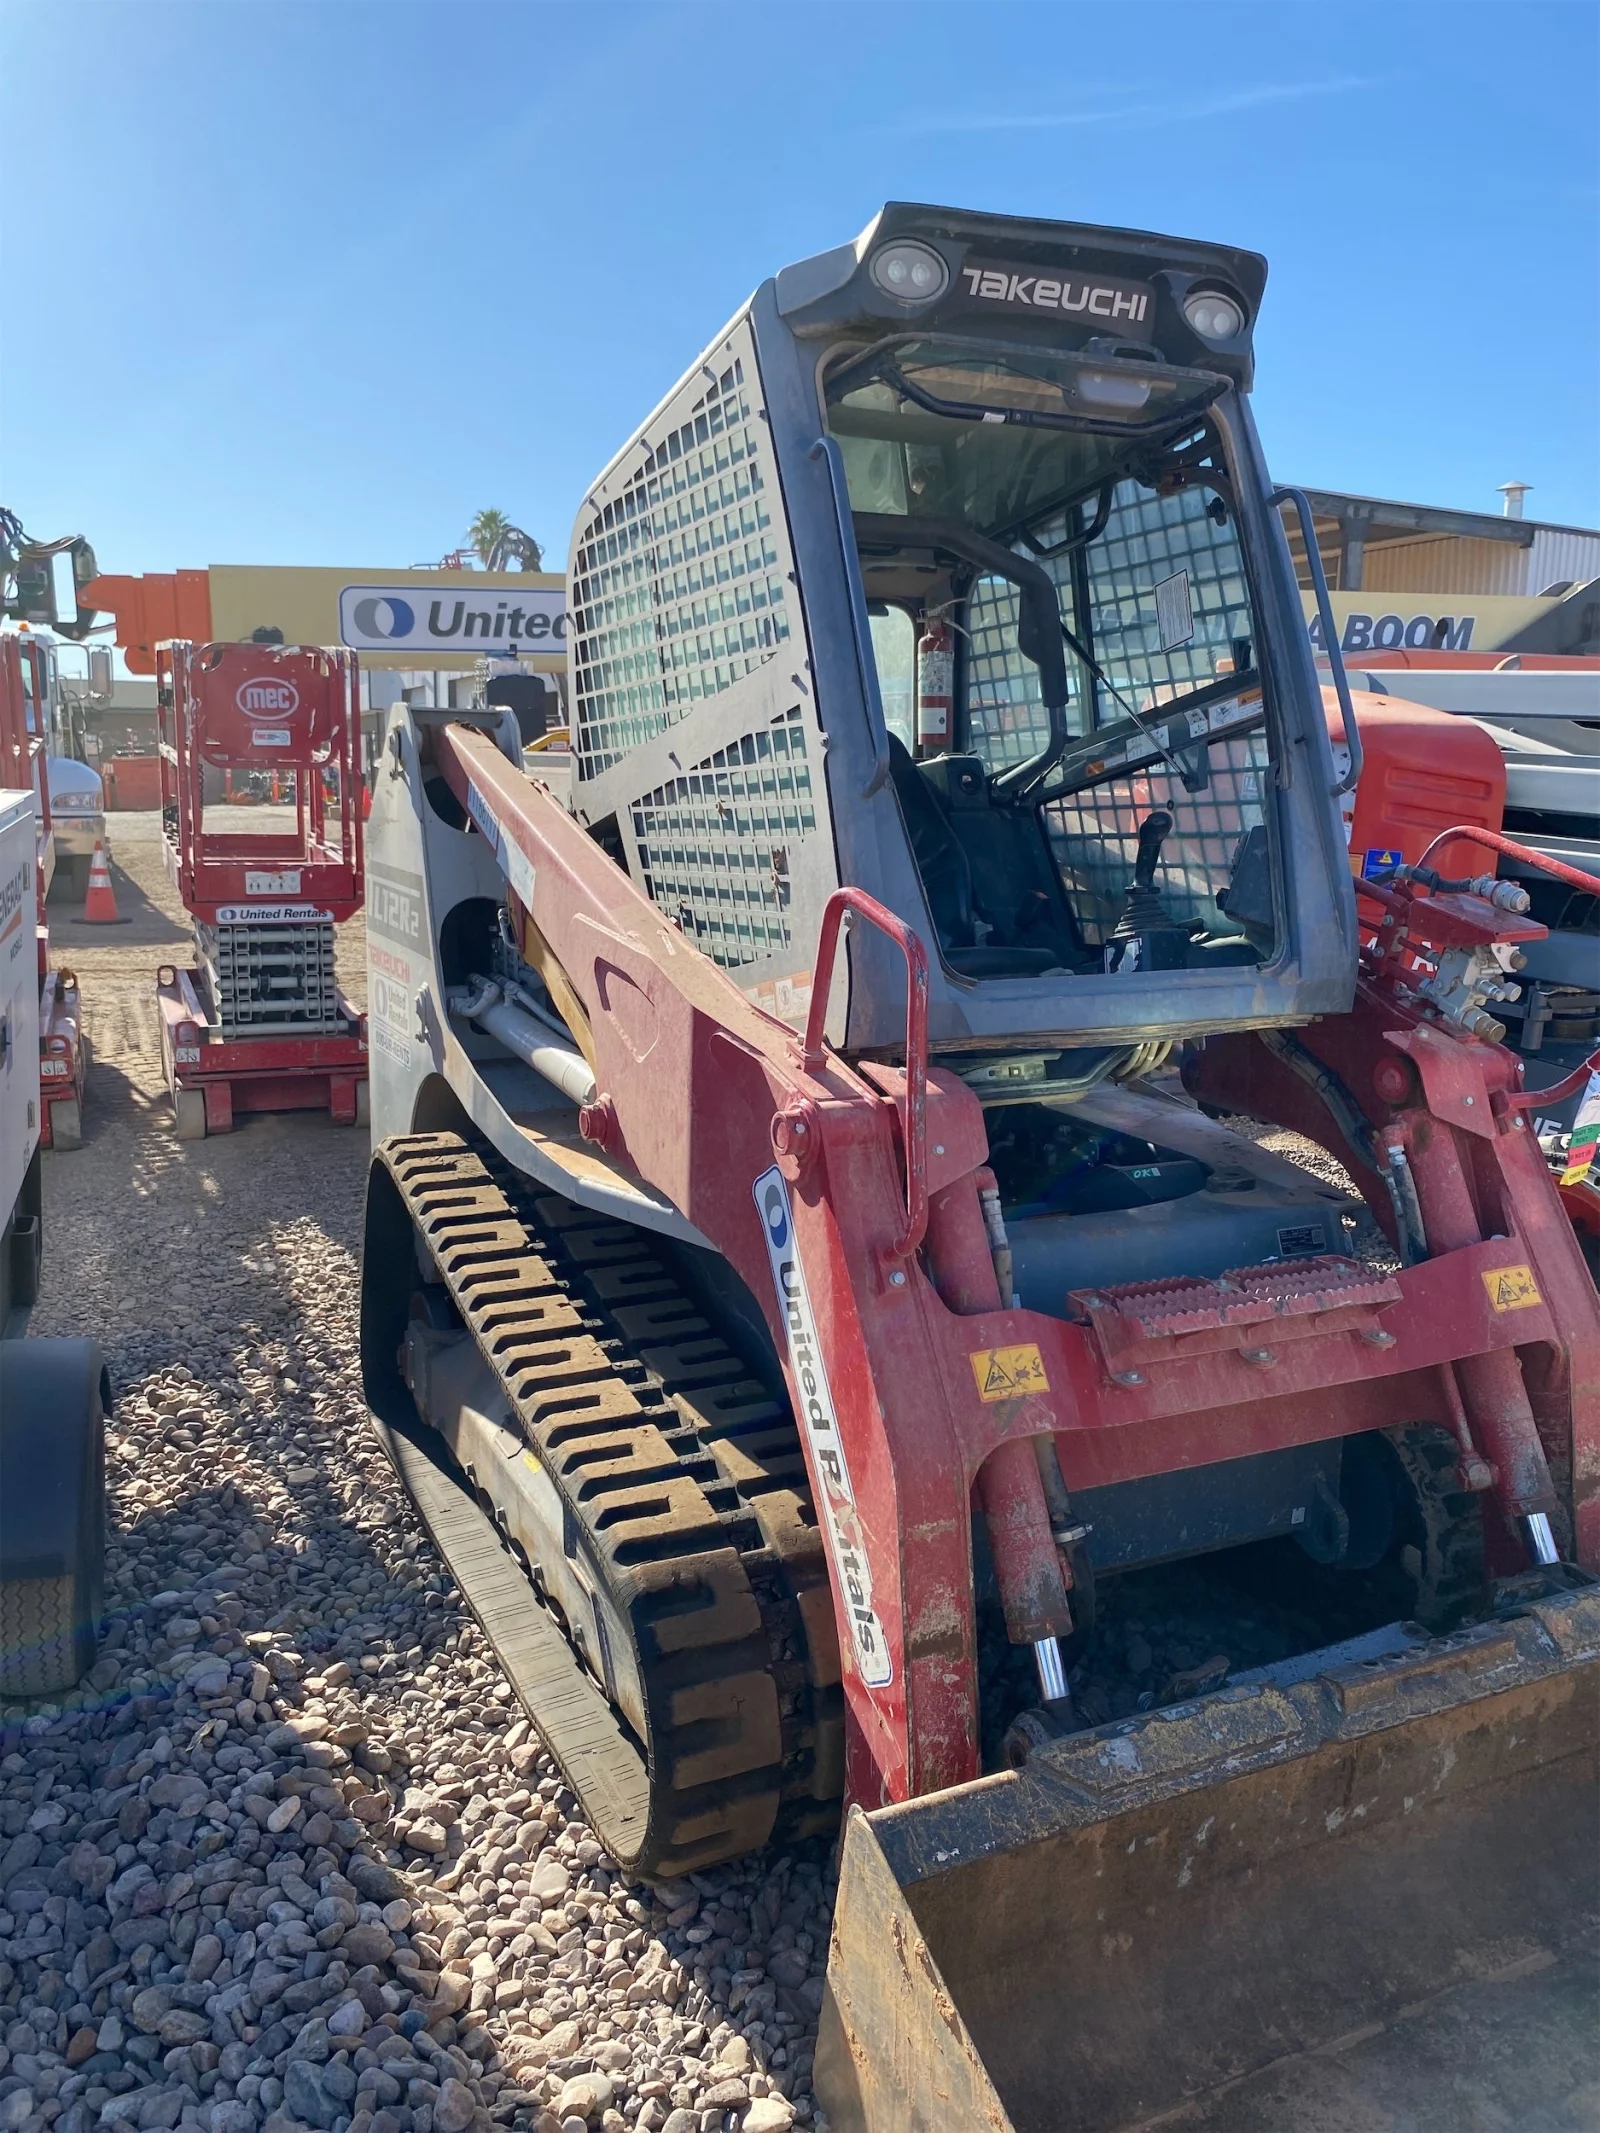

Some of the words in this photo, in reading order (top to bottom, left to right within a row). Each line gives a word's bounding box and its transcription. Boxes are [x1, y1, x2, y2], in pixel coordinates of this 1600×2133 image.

[963, 268, 1148, 322] TAKEUCHI
[1341, 613, 1476, 652] BOOM
[240, 908, 281, 920] United
[284, 907, 328, 919] Rentals
[779, 1260, 831, 1431] United
[818, 1449, 875, 1654] Rtals
